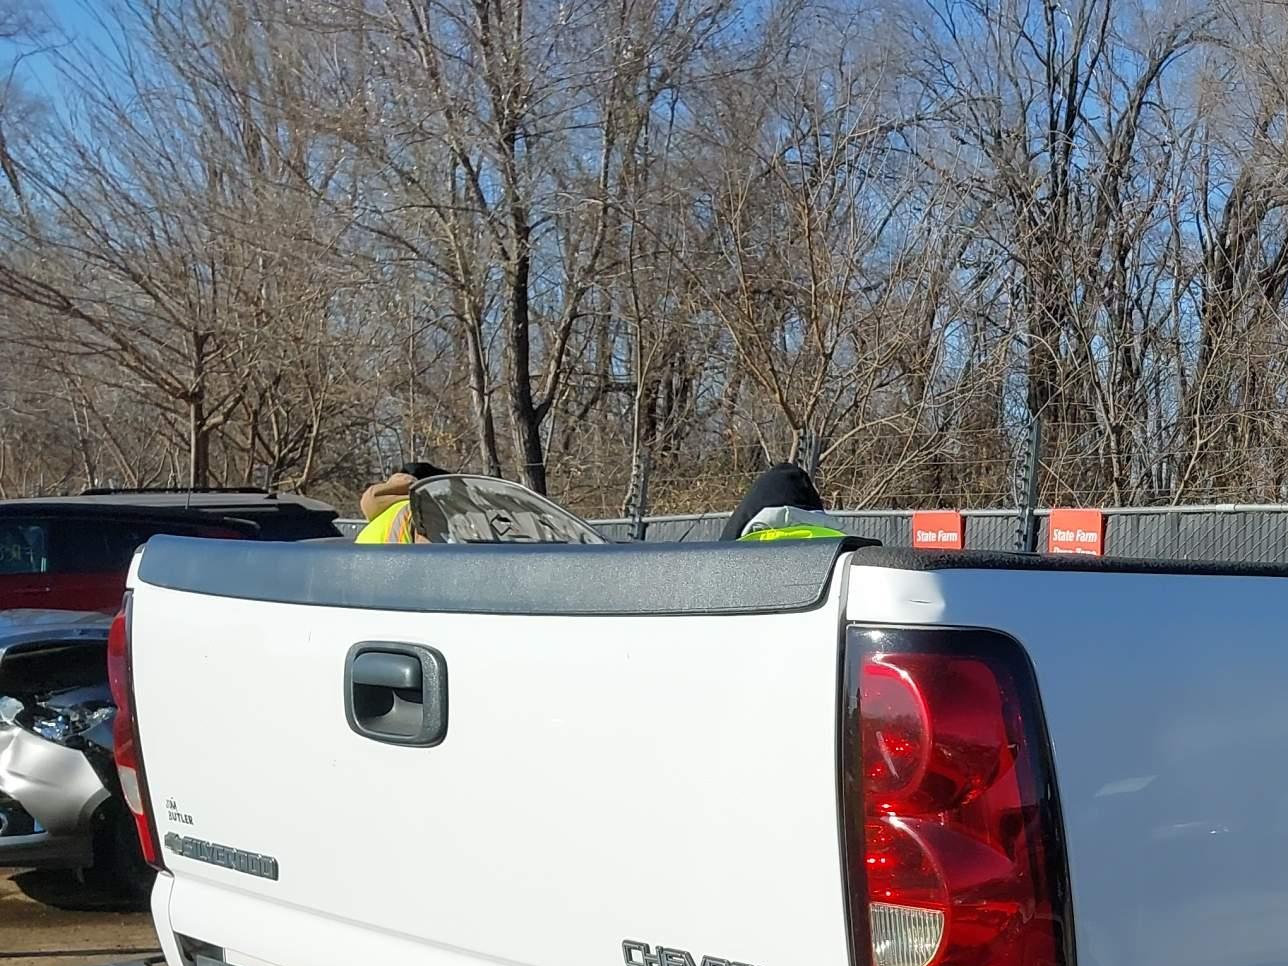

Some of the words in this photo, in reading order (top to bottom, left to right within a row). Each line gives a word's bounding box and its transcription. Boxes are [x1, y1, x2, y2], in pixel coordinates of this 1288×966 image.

[916, 529, 937, 542] State
[937, 529, 959, 542] Farm
[1052, 528, 1075, 542] State
[1075, 529, 1098, 543] Farm
[168, 810, 194, 825] BUTLER
